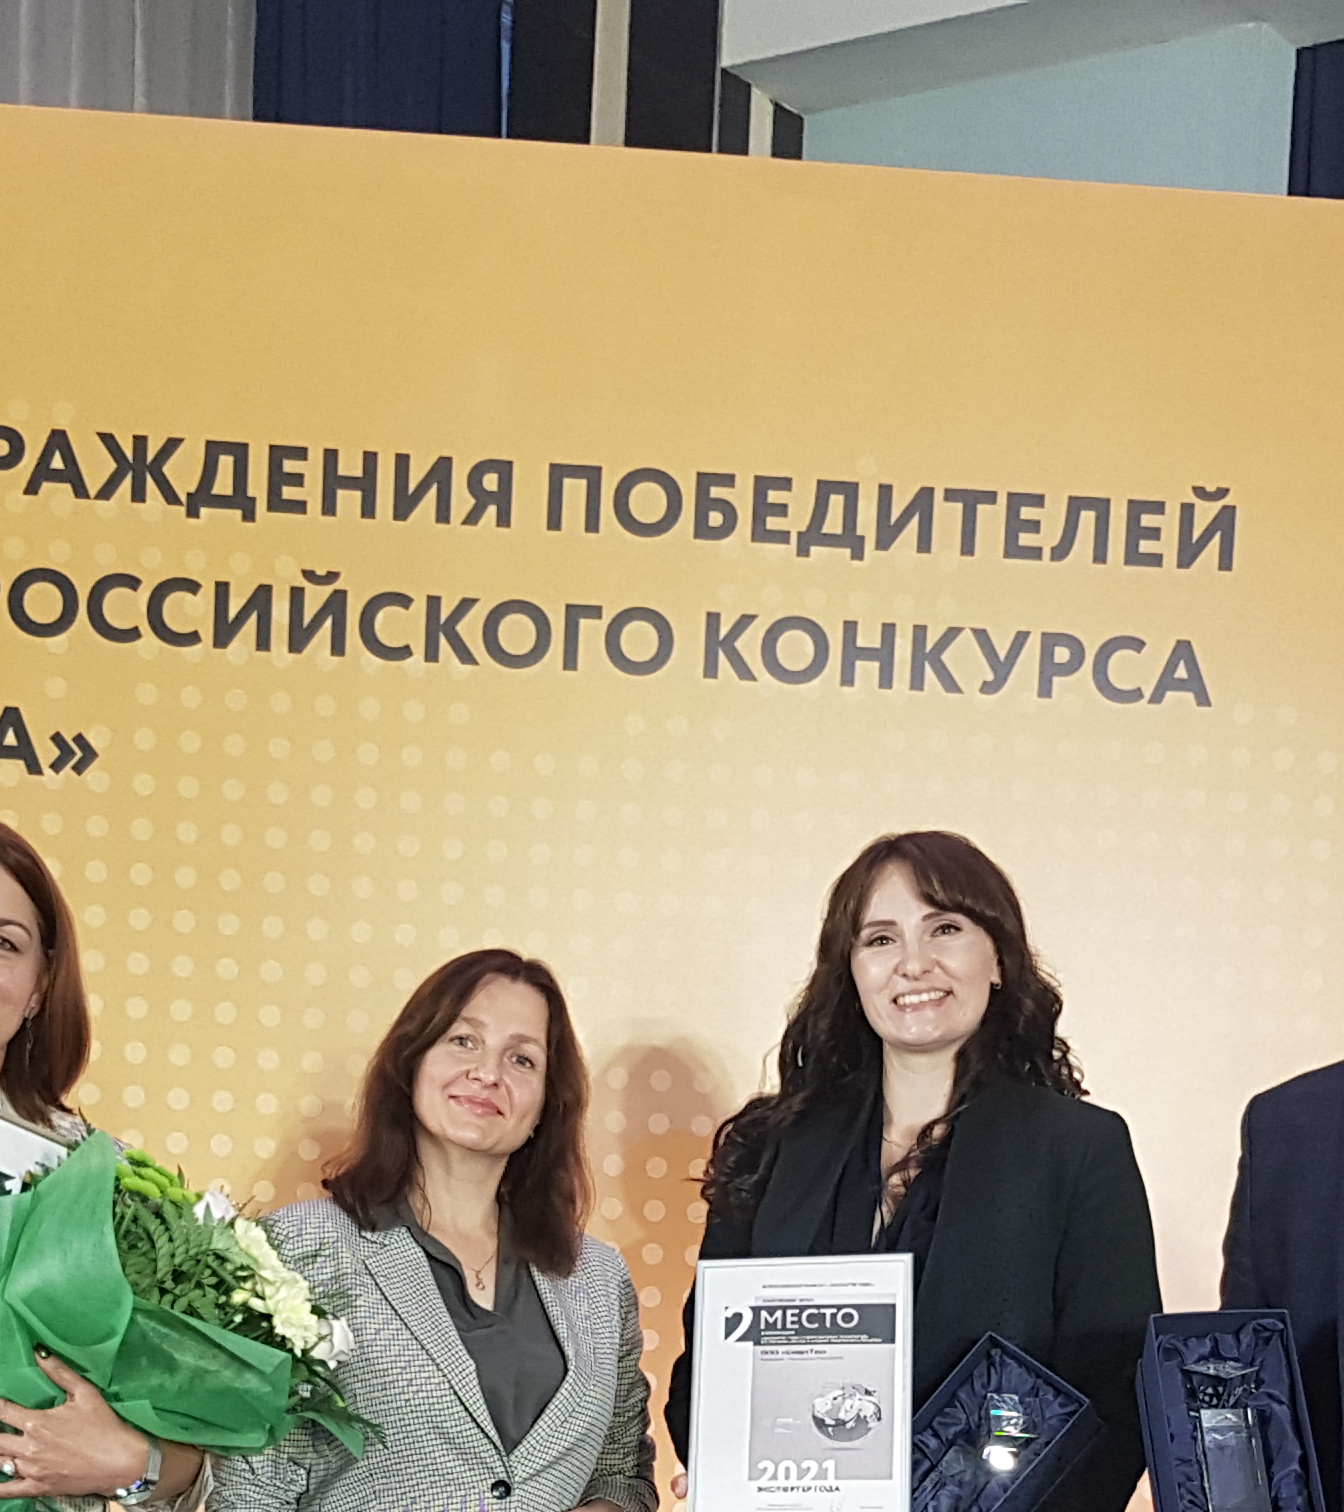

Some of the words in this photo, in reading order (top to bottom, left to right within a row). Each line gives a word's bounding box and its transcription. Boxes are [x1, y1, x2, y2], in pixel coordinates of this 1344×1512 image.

[546, 462, 1237, 572] ПОБЕДИТЕЛЕЙ
[702, 610, 1213, 708] КОНКУРСА
[759, 1307, 860, 1330] МЕСТО
[756, 1458, 836, 1482] 2021
